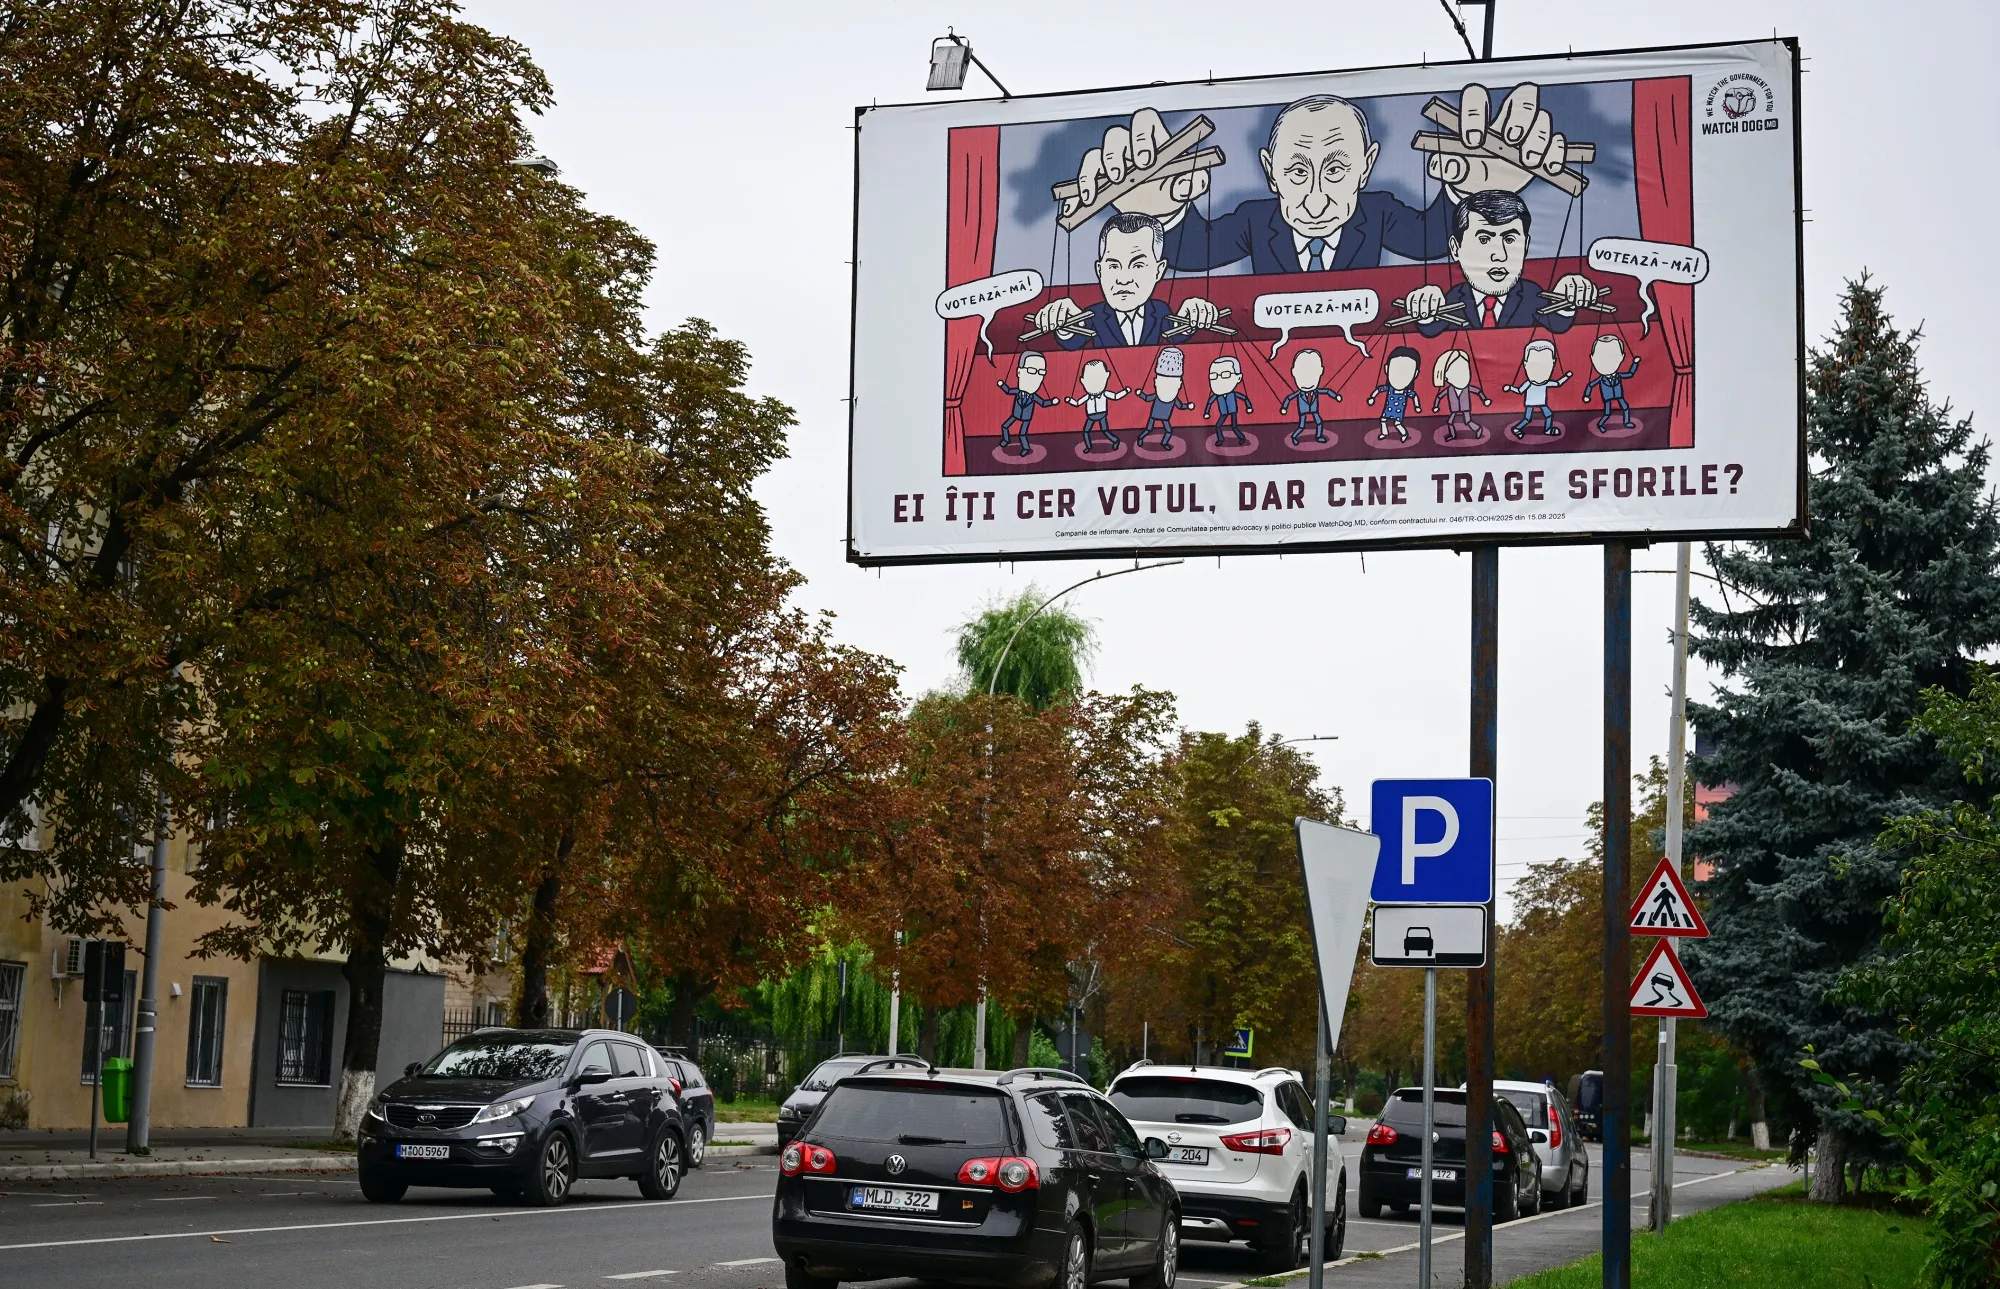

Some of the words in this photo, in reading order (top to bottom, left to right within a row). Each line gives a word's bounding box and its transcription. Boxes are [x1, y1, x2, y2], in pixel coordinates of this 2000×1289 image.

[1717, 77, 1729, 88] THE
[1729, 73, 1768, 89] GOVERNMENT
[1706, 86, 1719, 106] WATCH
[1764, 88, 1774, 100] FOR
[1706, 107, 1714, 118] WE
[1766, 101, 1774, 113] YOU
[1702, 121, 1739, 135] WATCH
[1742, 119, 1763, 133] DOG
[893, 493, 925, 524] EI
[1016, 488, 1076, 520] CER
[1098, 482, 1217, 516] VOTUL,
[1238, 479, 1306, 512] DAR
[1327, 474, 1408, 508] CINE
[1431, 470, 1545, 504] TRAGE
[1568, 463, 1744, 500] SFORILE?
[1055, 529, 1087, 538] Campanie
[1099, 528, 1132, 536] informare.
[1133, 526, 1155, 534] Achitat
[1167, 525, 1208, 533] Comunitatea
[1209, 525, 1230, 533] pentru
[1232, 523, 1263, 532] advocacy
[1272, 522, 1292, 531] politici
[1293, 521, 1317, 530] publice
[1318, 519, 1368, 529] WatchDog.MD,
[1370, 518, 1397, 526] conform
[1398, 516, 1438, 525] contractului
[1514, 513, 1526, 521] din
[1528, 512, 1566, 521] 15.08.2025
[1402, 795, 1460, 884] P
[425, 1146, 448, 1157] 5967
[1181, 1149, 1202, 1161] 204
[1436, 1170, 1452, 1179] 172
[865, 1188, 893, 1205] MLD
[904, 1191, 931, 1208] 322
